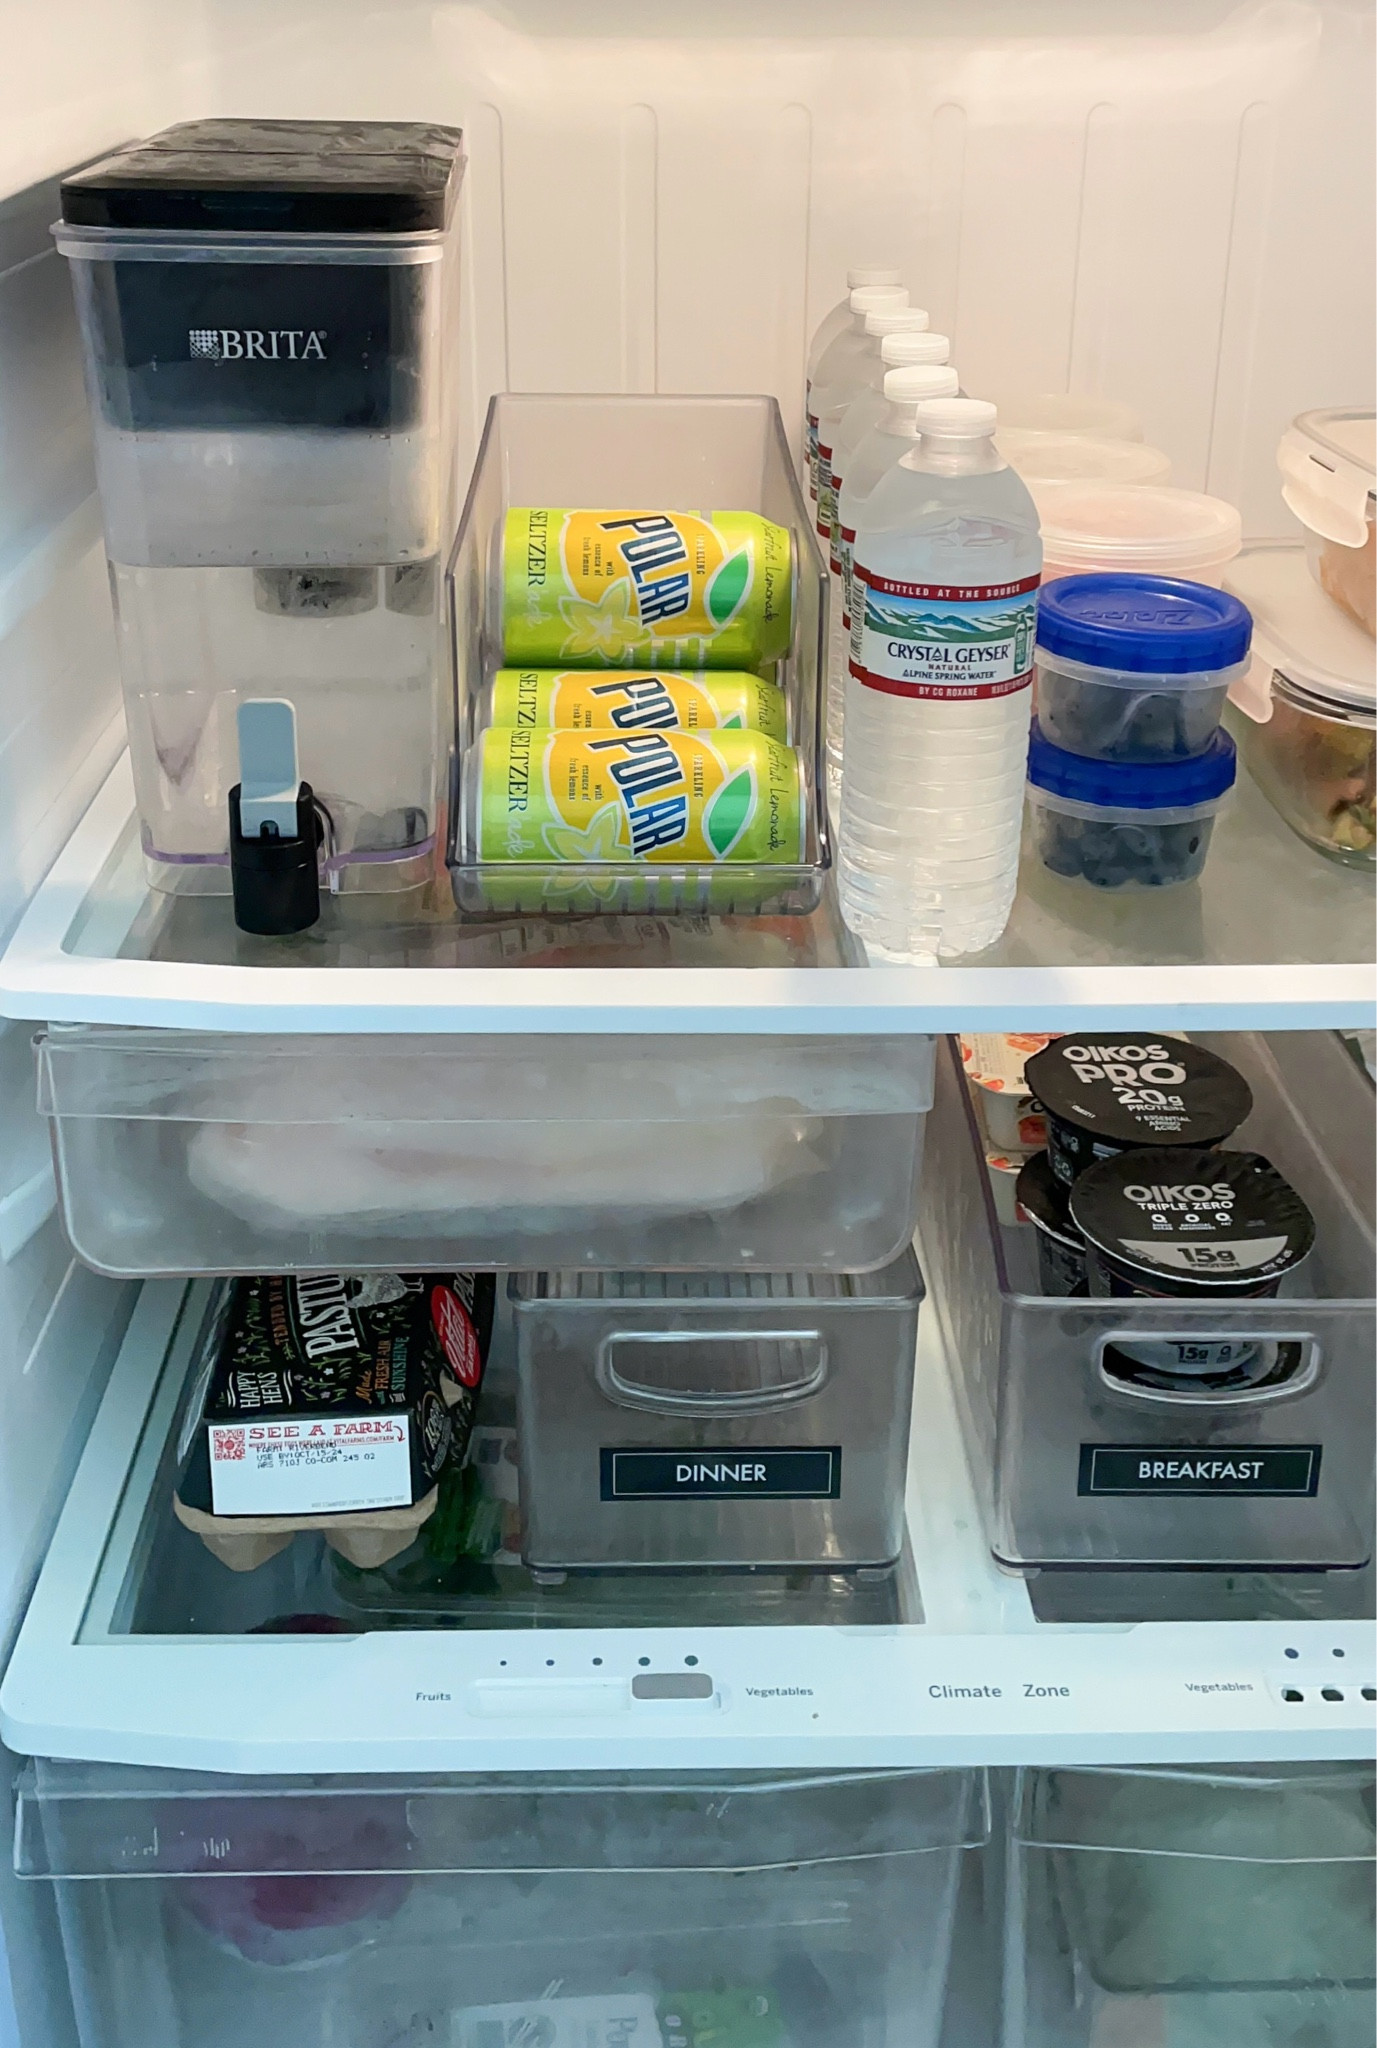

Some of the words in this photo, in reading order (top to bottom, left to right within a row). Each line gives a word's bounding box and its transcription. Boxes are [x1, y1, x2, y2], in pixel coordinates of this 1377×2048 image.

[219, 330, 328, 360] BRITA
[528, 510, 549, 586] SELTZER
[599, 515, 692, 627] POLAR
[762, 565, 782, 624] Lemonade
[883, 582, 930, 597] BOTTLED
[937, 589, 951, 598] AT
[959, 590, 980, 598] THE
[986, 584, 1021, 598] SOURCE
[888, 642, 953, 663] CRYSTAL
[955, 644, 1009, 663] GEYSER
[902, 669, 934, 680] ALPINE
[935, 672, 967, 680] SPRING
[967, 671, 996, 680] WATER
[518, 673, 539, 728] SELTZ
[919, 686, 930, 695] BY
[932, 687, 944, 696] CG
[946, 687, 979, 696] ROXANE
[508, 731, 532, 813] SELTZER
[588, 734, 688, 855] POLAR
[768, 782, 789, 853] Lemonade
[1062, 1044, 1170, 1062] OIKOS
[1070, 1062, 1187, 1087] PRO
[1112, 1086, 1184, 1107] 20g
[1127, 1104, 1187, 1112] PROTEIN
[1123, 1183, 1236, 1203] OIKOS
[1137, 1202, 1189, 1211] TRIPLE
[1192, 1201, 1234, 1210] ZERO
[1177, 1247, 1236, 1262] 15g
[297, 1275, 360, 1359] PASTU
[378, 1340, 392, 1358] AIR
[391, 1336, 410, 1391] SUNSHINE
[374, 1358, 390, 1390] FRESH
[237, 1371, 261, 1409] HAPPY
[257, 1371, 283, 1405] HENS
[249, 1426, 299, 1439] SEE
[308, 1424, 326, 1436] A
[334, 1421, 393, 1435] FARM
[676, 1464, 767, 1482] DINNER
[1138, 1461, 1265, 1480] BREAKFAST
[415, 1691, 452, 1703] Fruits
[745, 1686, 814, 1699] Vegetables
[928, 1684, 1003, 1699] Climate
[1023, 1684, 1071, 1698] Zone
[1185, 1681, 1254, 1694] Vegetables
